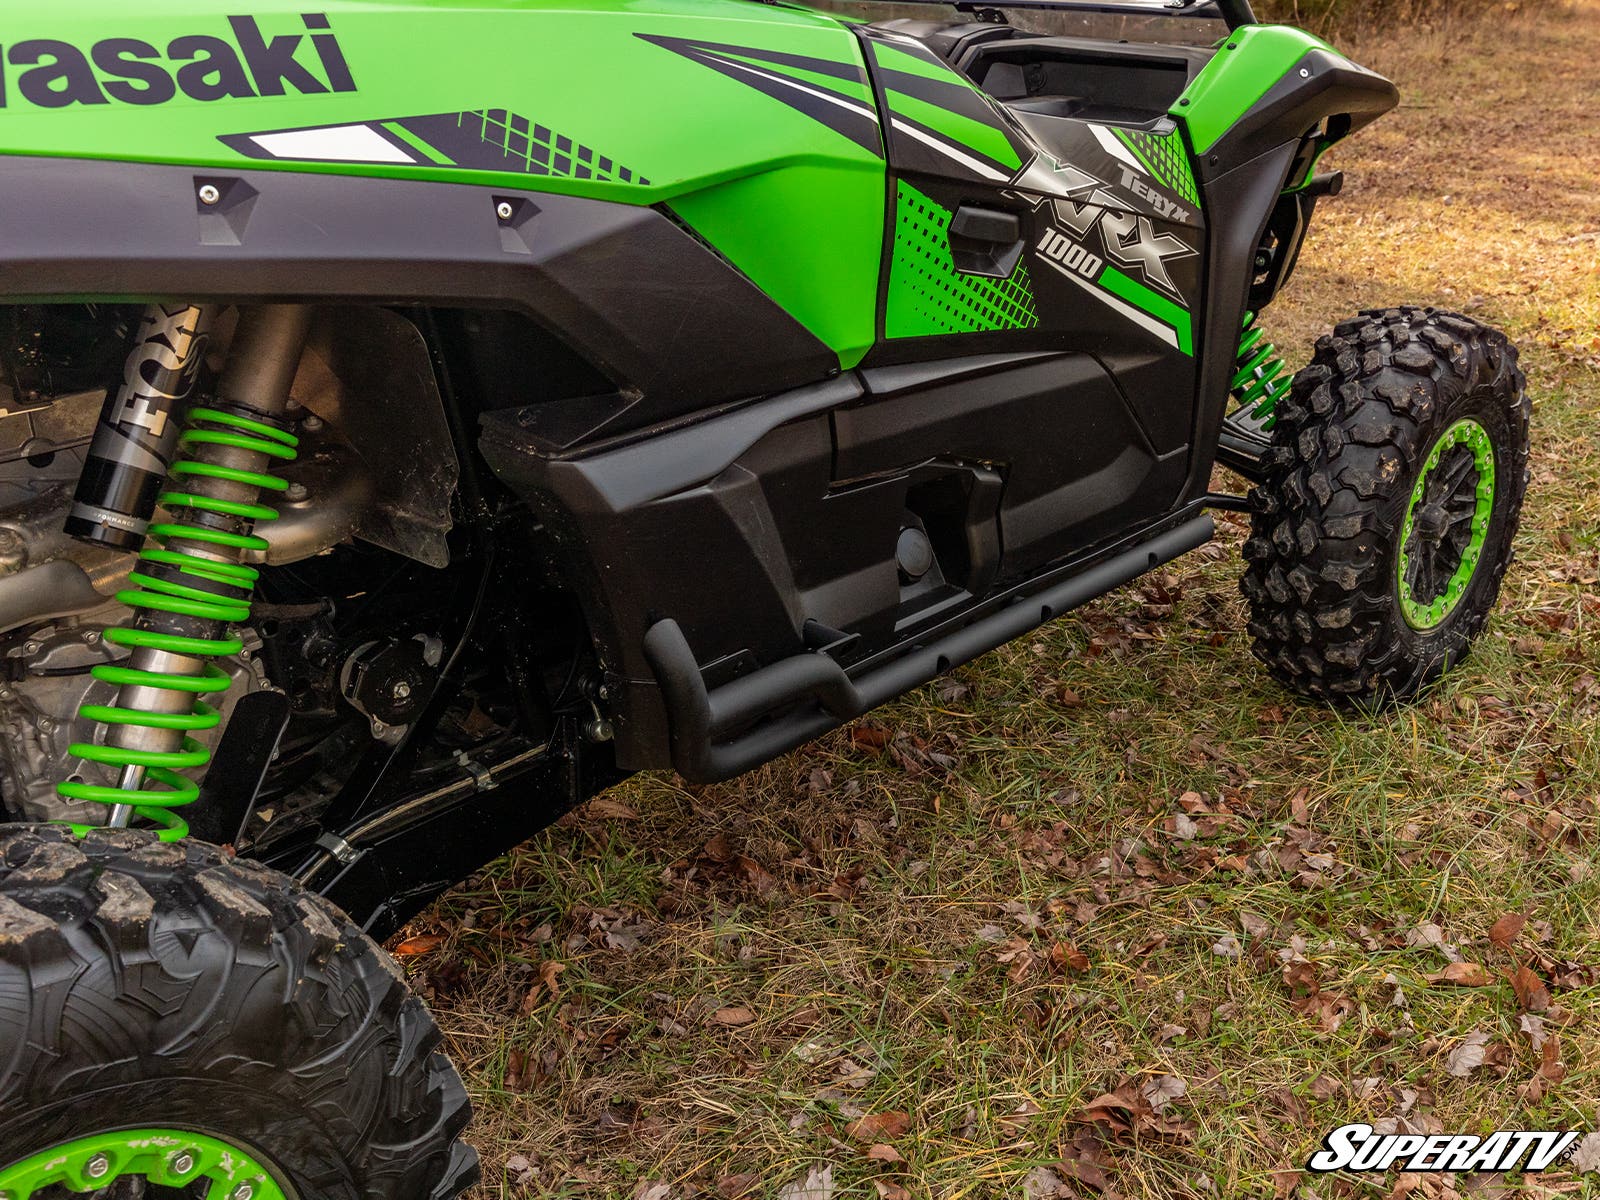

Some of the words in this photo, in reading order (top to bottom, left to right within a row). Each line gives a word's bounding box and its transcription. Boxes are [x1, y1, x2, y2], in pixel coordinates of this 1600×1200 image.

[0, 13, 358, 108] asaki
[1117, 162, 1190, 223] TERYX
[1036, 226, 1103, 279] 1000
